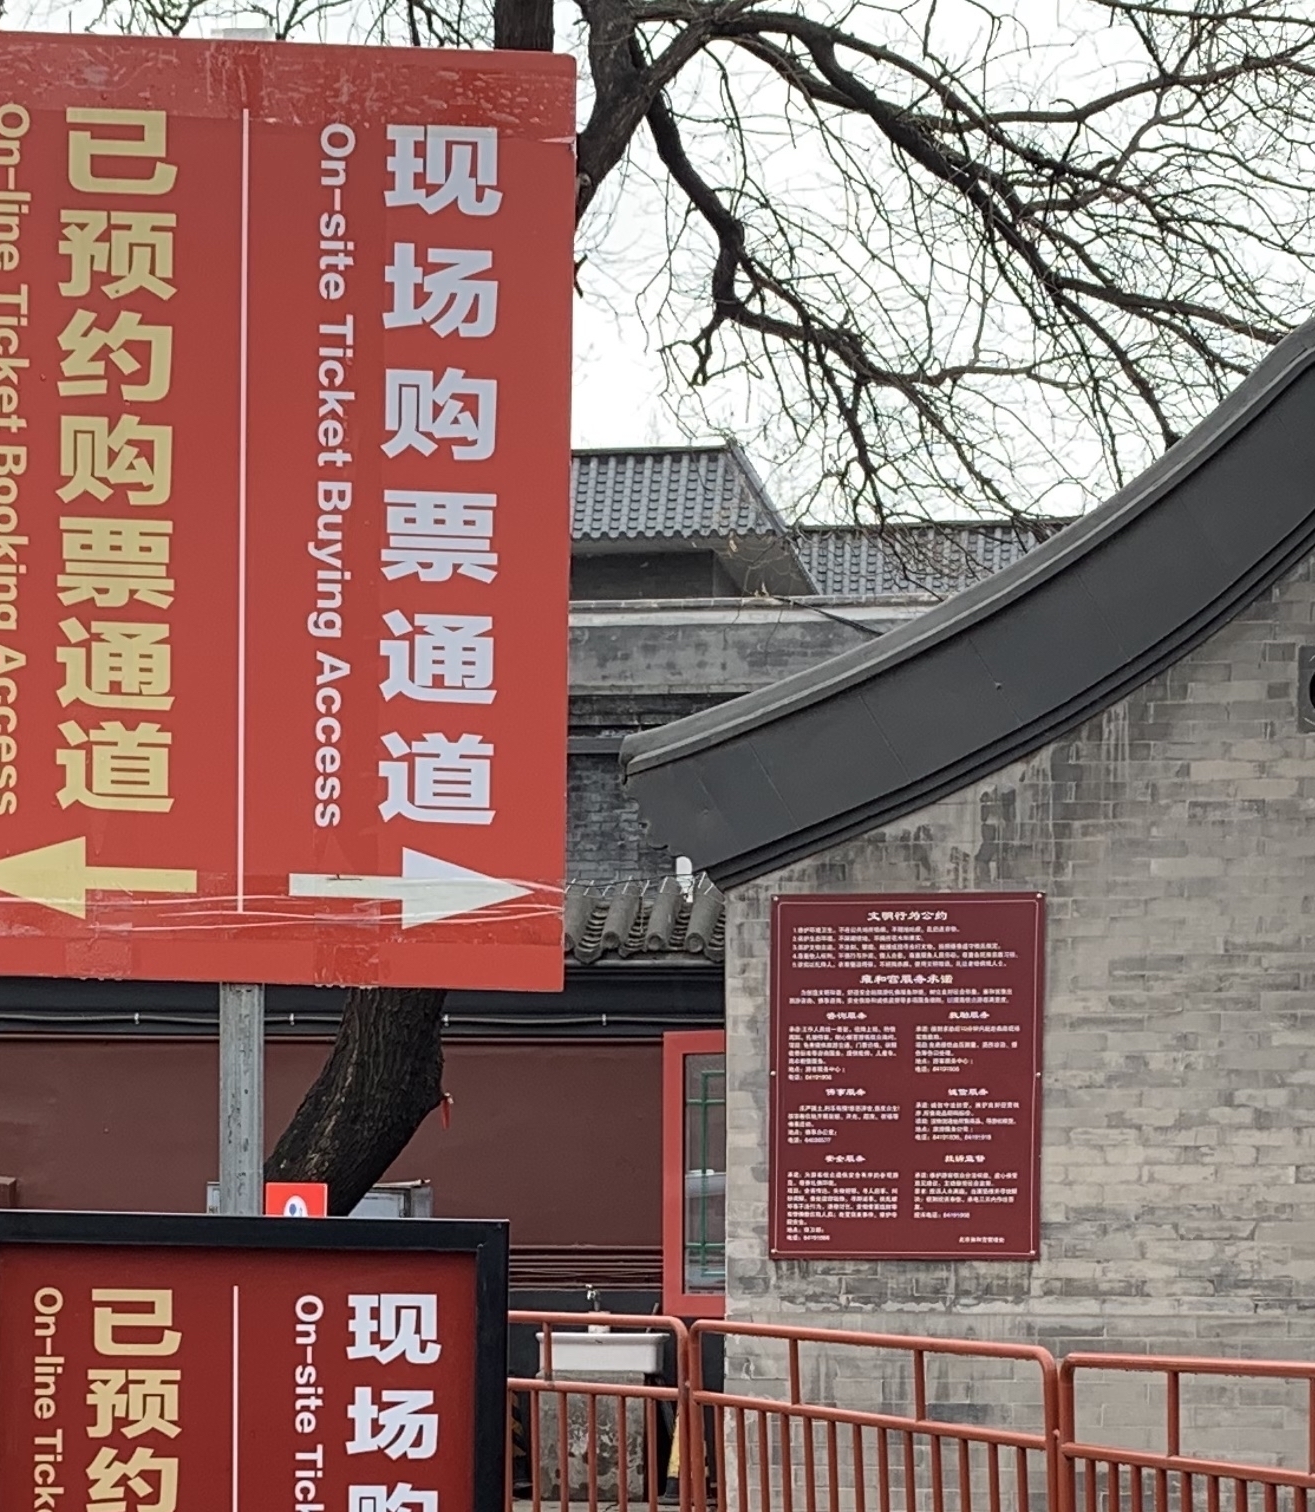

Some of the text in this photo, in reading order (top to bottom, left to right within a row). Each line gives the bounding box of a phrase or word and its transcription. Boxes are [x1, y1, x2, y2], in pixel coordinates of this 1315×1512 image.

[55, 106, 178, 813] 已预约购票通道
[308, 122, 356, 828] On-site Ticket Buying Access
[378, 124, 503, 826] 现场购票通道
[867, 911, 948, 921] 文明行为公约
[34, 1287, 65, 1419] On-line
[295, 1294, 324, 1434] On-site
